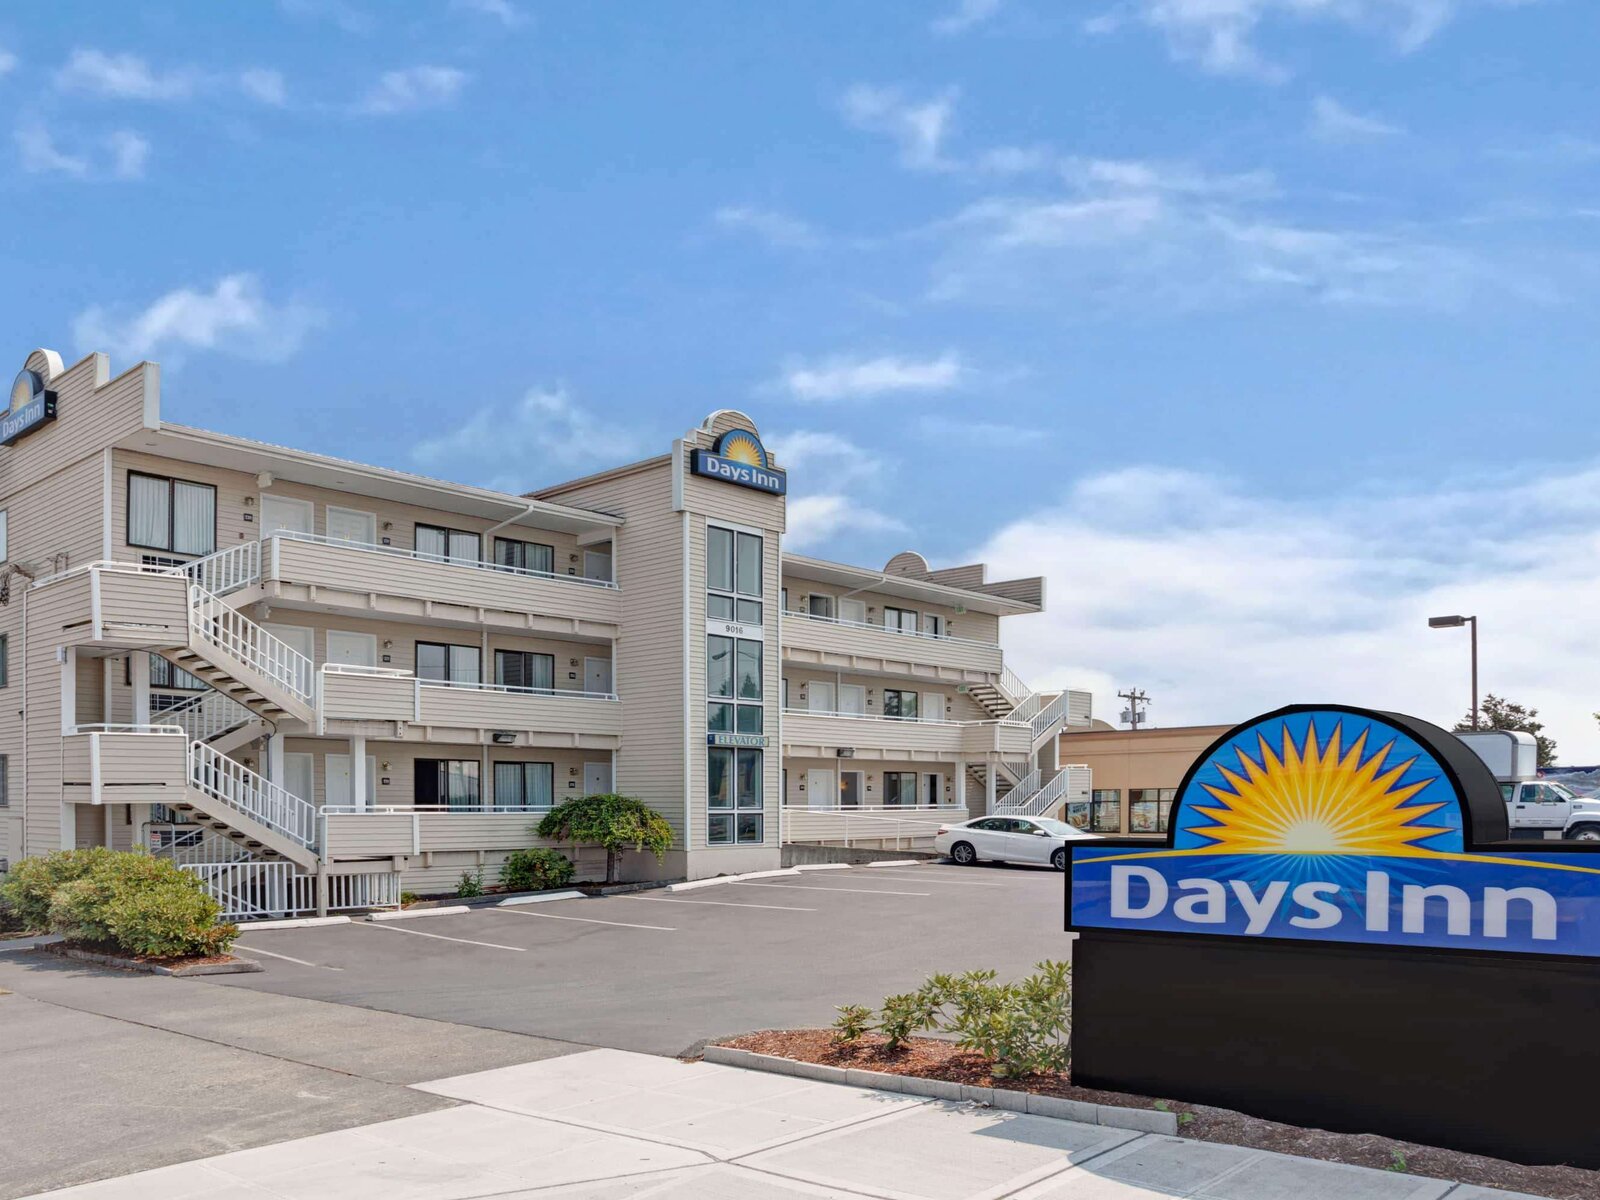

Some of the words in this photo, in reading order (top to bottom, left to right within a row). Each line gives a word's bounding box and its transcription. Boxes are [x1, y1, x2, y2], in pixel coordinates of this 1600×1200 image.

[2, 413, 25, 438] Days
[25, 403, 41, 424] Inn
[706, 456, 750, 481] Days
[752, 469, 779, 489] Inn
[725, 624, 744, 634] 9016
[719, 735, 765, 746] ELEVATOR
[1110, 864, 1343, 935] Days
[1365, 870, 1558, 940] Inn
